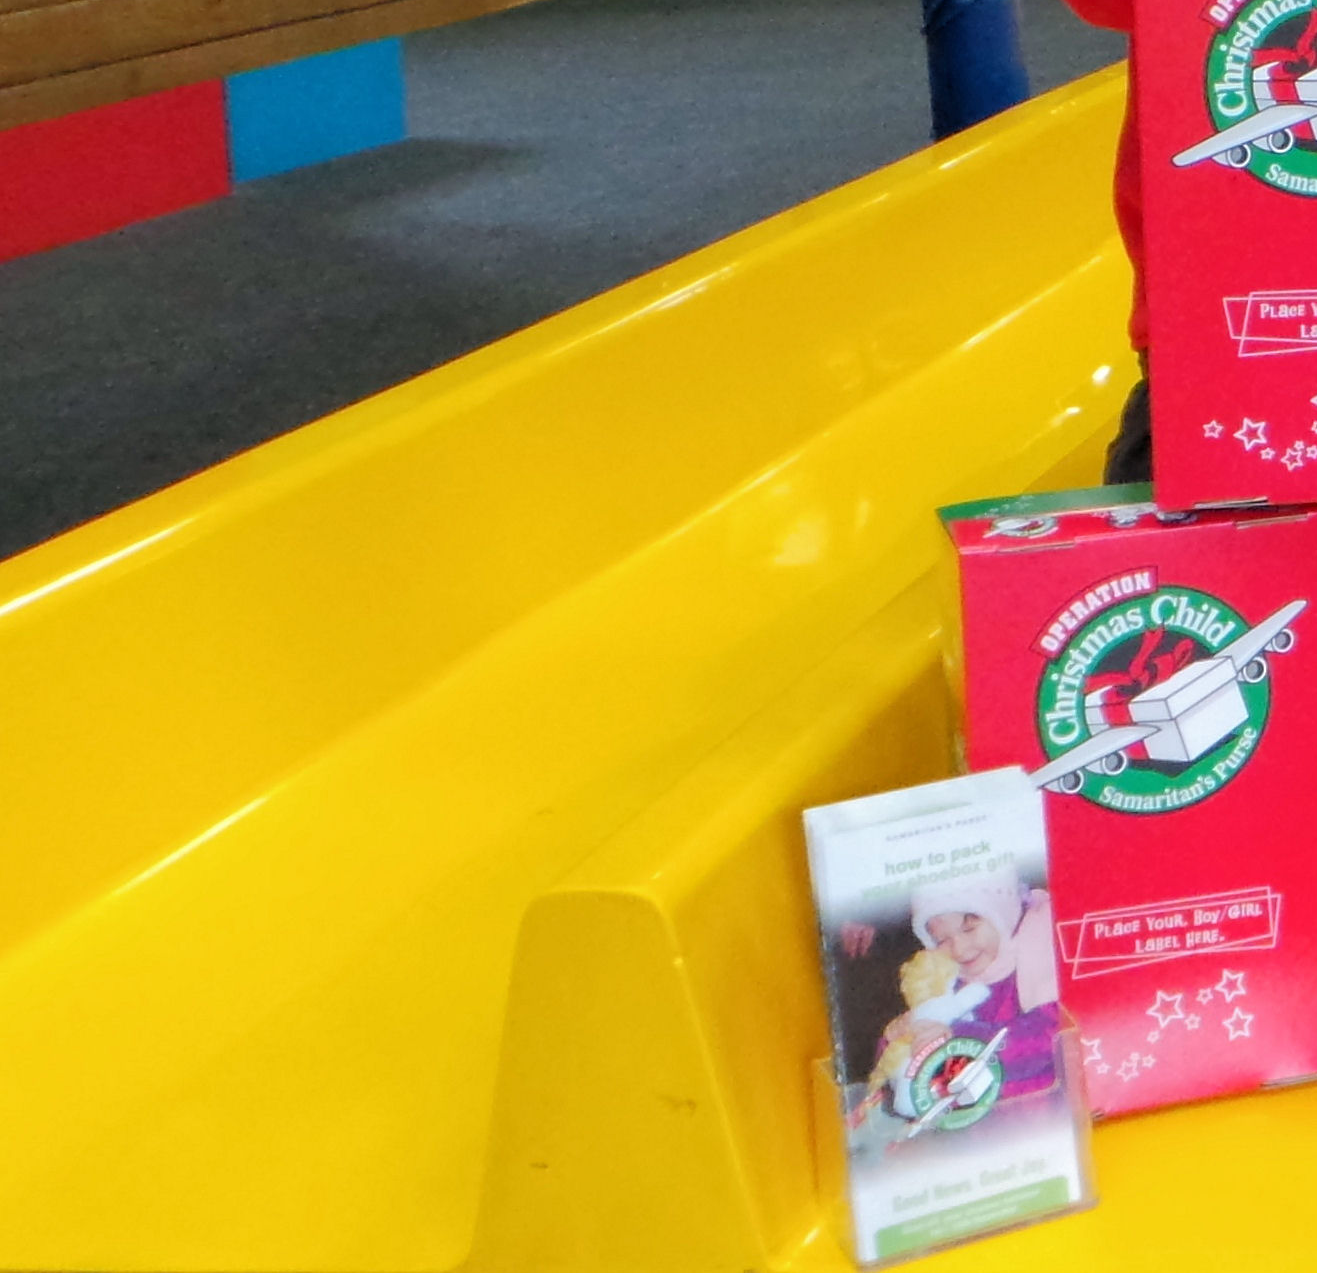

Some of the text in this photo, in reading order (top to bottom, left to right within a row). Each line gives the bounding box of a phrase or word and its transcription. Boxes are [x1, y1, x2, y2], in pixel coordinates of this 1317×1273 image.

[1040, 571, 1150, 653] OPERATION
[1046, 595, 1236, 746] Christmas Child
[1101, 727, 1258, 810] Samaritan's Purse
[884, 840, 991, 876] how to pack
